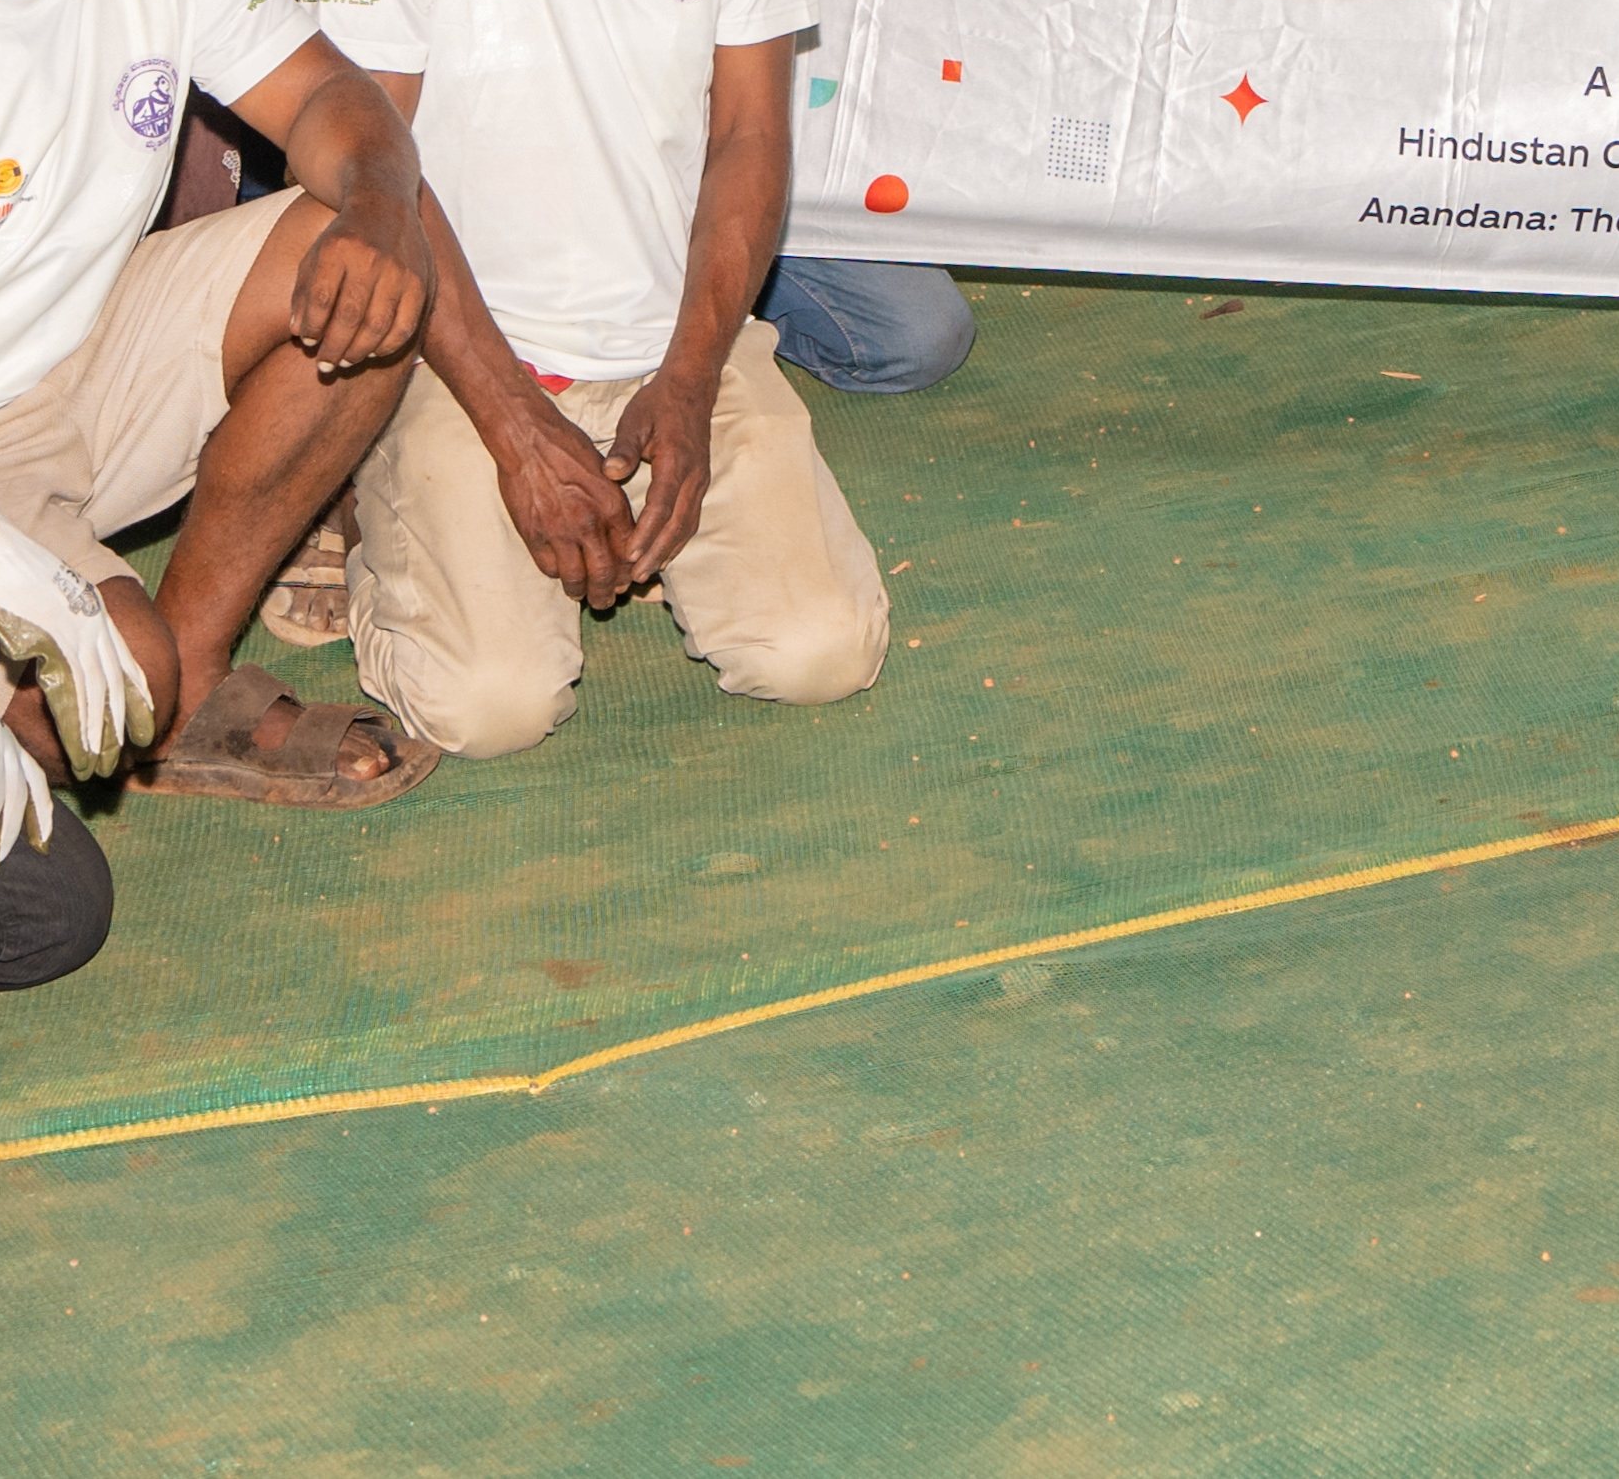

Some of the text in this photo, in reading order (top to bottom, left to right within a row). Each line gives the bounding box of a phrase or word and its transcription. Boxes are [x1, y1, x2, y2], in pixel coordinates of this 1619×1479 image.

[1584, 67, 1612, 98] A
[1397, 128, 1589, 170] Hindustan
[1358, 197, 1558, 233] Anandana:
